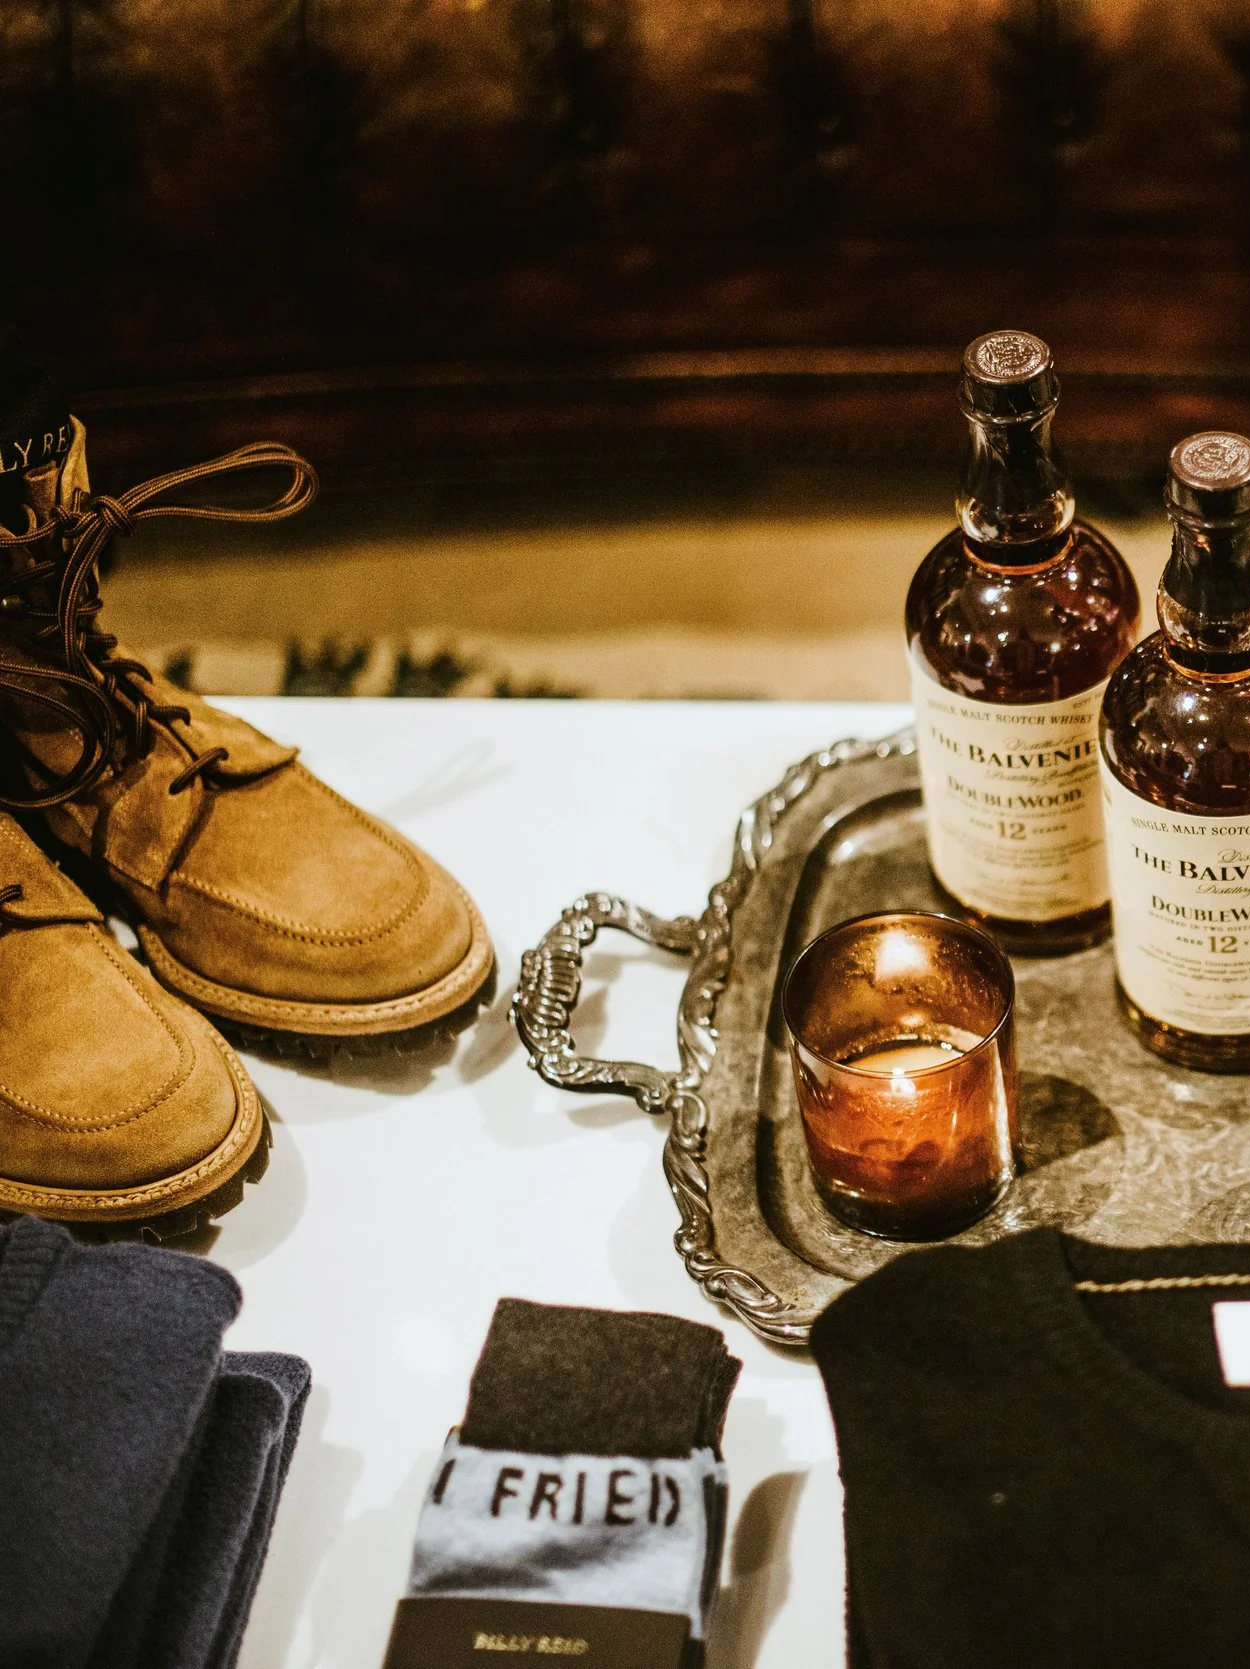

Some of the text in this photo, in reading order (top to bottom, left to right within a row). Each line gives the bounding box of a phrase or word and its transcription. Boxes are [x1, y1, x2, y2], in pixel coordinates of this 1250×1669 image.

[42, 424, 71, 457] RE
[995, 714, 1046, 724] SCOTCH
[1050, 713, 1094, 725] WHISKY
[931, 725, 1098, 769] THE BALVENIE
[996, 821, 1027, 840] 12
[1131, 817, 1169, 832] SINGLE
[1172, 824, 1207, 836] MALT
[1131, 843, 1173, 875] THE
[1176, 936, 1203, 946] AGED
[1207, 935, 1239, 954] 12
[432, 1457, 682, 1527] I FRIED
